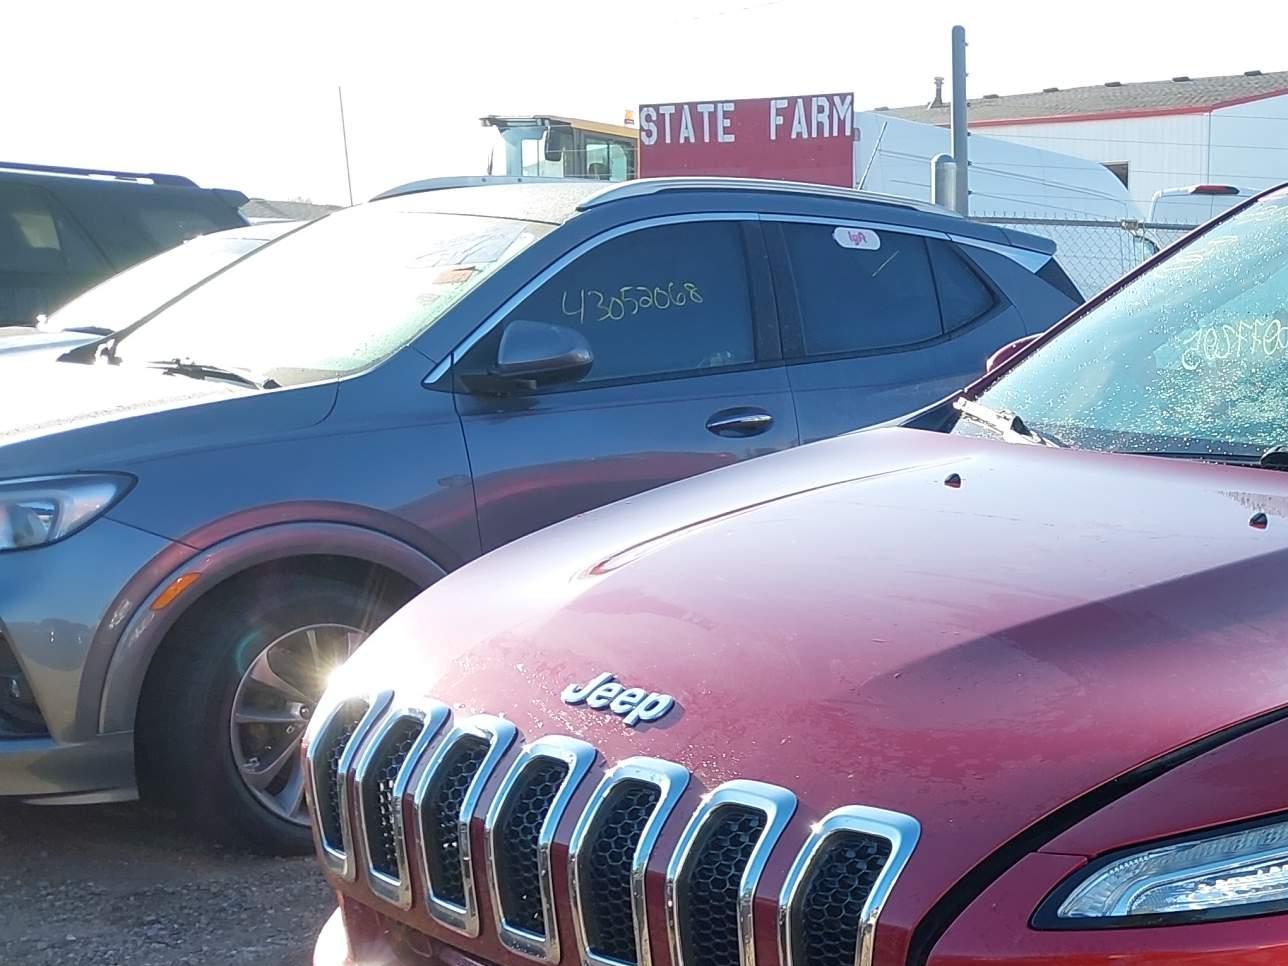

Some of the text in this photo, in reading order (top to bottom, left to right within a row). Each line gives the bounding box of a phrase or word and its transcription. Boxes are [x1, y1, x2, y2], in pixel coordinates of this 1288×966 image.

[639, 95, 853, 146] STATE FARM
[561, 282, 704, 325] 43052068
[560, 671, 677, 728] Jeep
